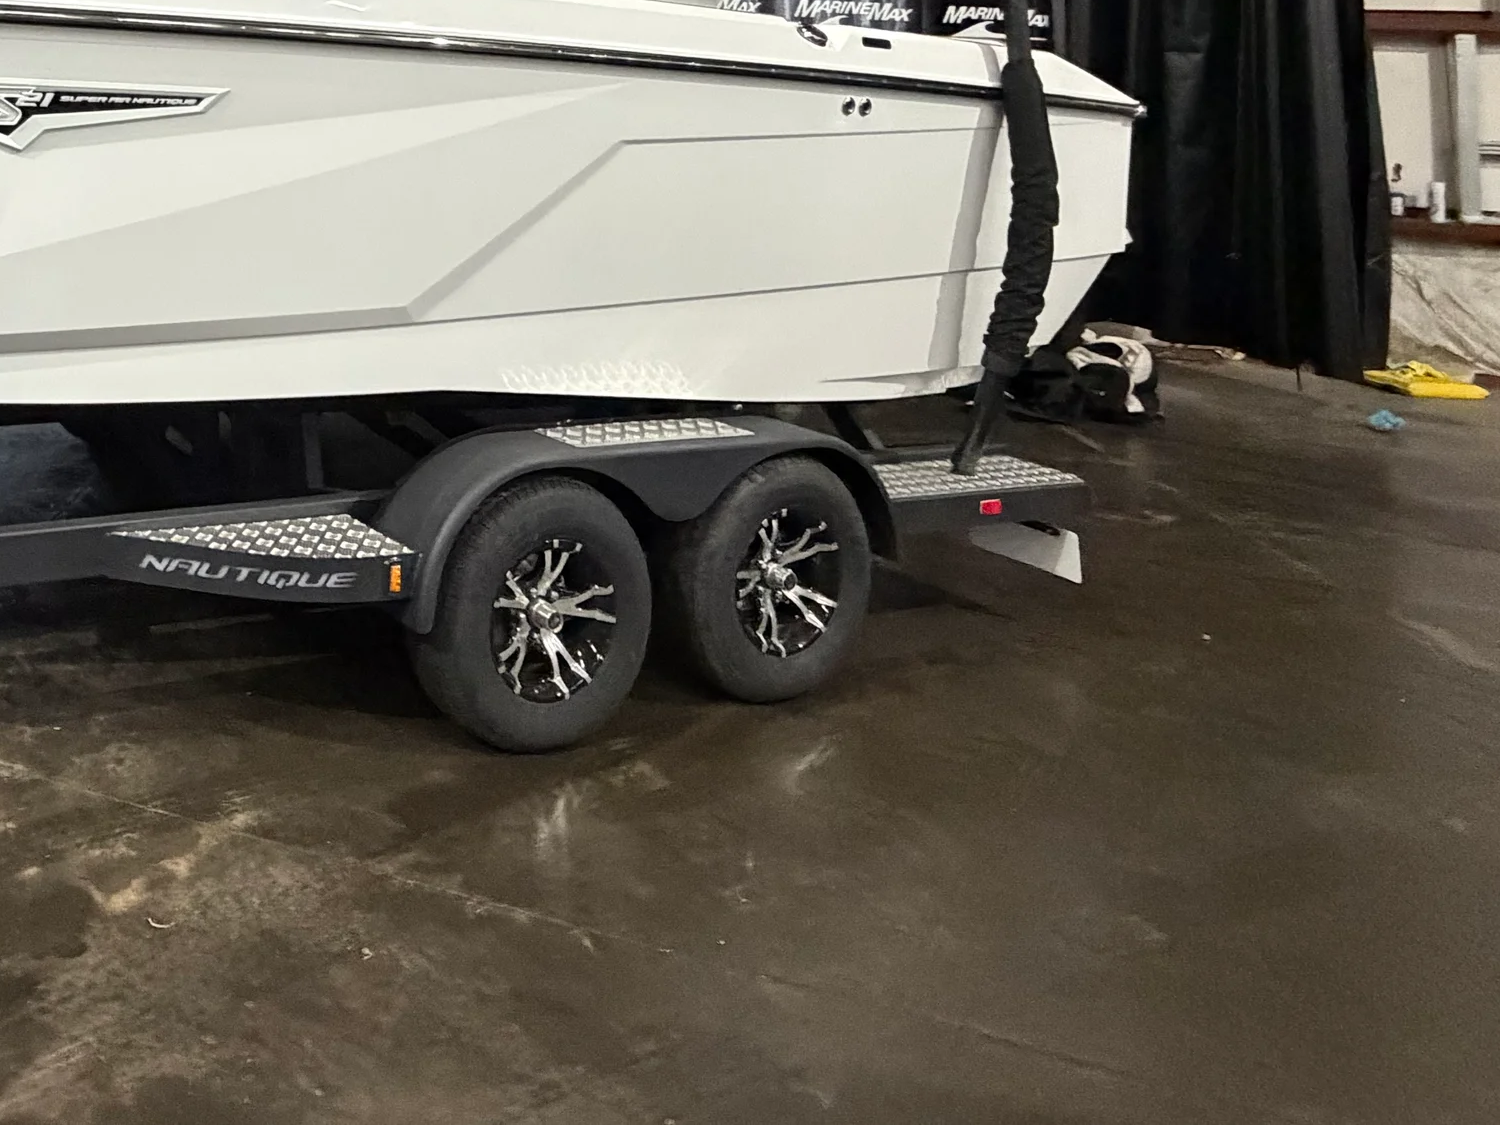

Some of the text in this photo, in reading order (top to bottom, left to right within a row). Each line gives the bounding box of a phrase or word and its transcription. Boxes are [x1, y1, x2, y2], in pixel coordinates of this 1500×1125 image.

[59, 95, 108, 103] SUPER
[132, 97, 197, 106] NAUTIQUE
[139, 553, 359, 589] NAUTIQUE
